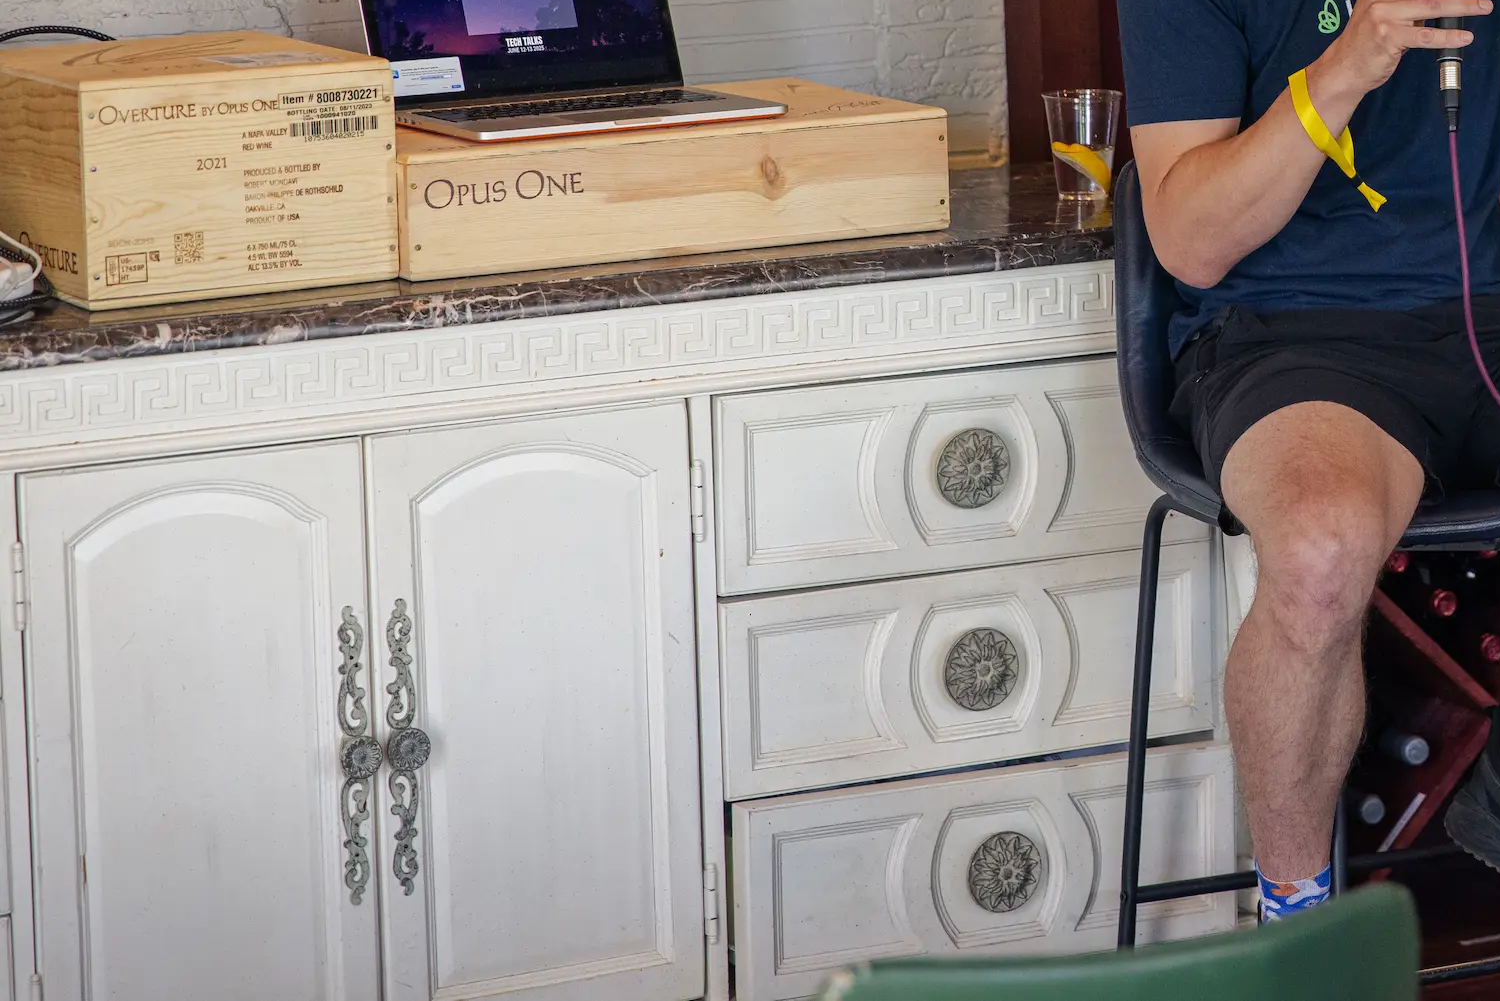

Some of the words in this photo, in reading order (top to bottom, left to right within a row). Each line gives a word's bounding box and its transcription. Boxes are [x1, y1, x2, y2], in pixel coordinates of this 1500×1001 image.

[505, 37, 523, 47] TECH
[522, 36, 543, 46] TALKS
[282, 95, 304, 104] Item
[308, 94, 314, 102] #
[316, 88, 378, 104] 8008730221
[98, 104, 197, 126] OVERTURE
[201, 106, 215, 116] BY
[217, 102, 249, 115] OPUS
[252, 99, 278, 112] ONE
[287, 108, 318, 116] BOTTLING
[340, 103, 373, 111] 08/11/2023
[248, 129, 265, 138] NAPA
[266, 127, 288, 137] VALLEY
[242, 143, 255, 151] RED
[256, 141, 273, 150] WINE
[197, 158, 228, 171] 2021
[244, 167, 276, 177] PRODUCED
[284, 163, 311, 173] BOTTLED
[313, 163, 321, 171] BY
[267, 190, 294, 199] PHILIPPE
[296, 188, 304, 196] DE
[305, 185, 343, 195] ROTHSCHILD
[424, 179, 508, 209] OPUS
[515, 169, 585, 200] ONE
[246, 215, 276, 224] PRODUCT
[277, 214, 286, 222] OF
[257, 242, 269, 250] 750
[269, 240, 288, 250] ML/75
[248, 263, 260, 272] ALC
[261, 261, 279, 270] 13.5%
[280, 260, 288, 268] BY
[288, 258, 303, 267] VOL.
